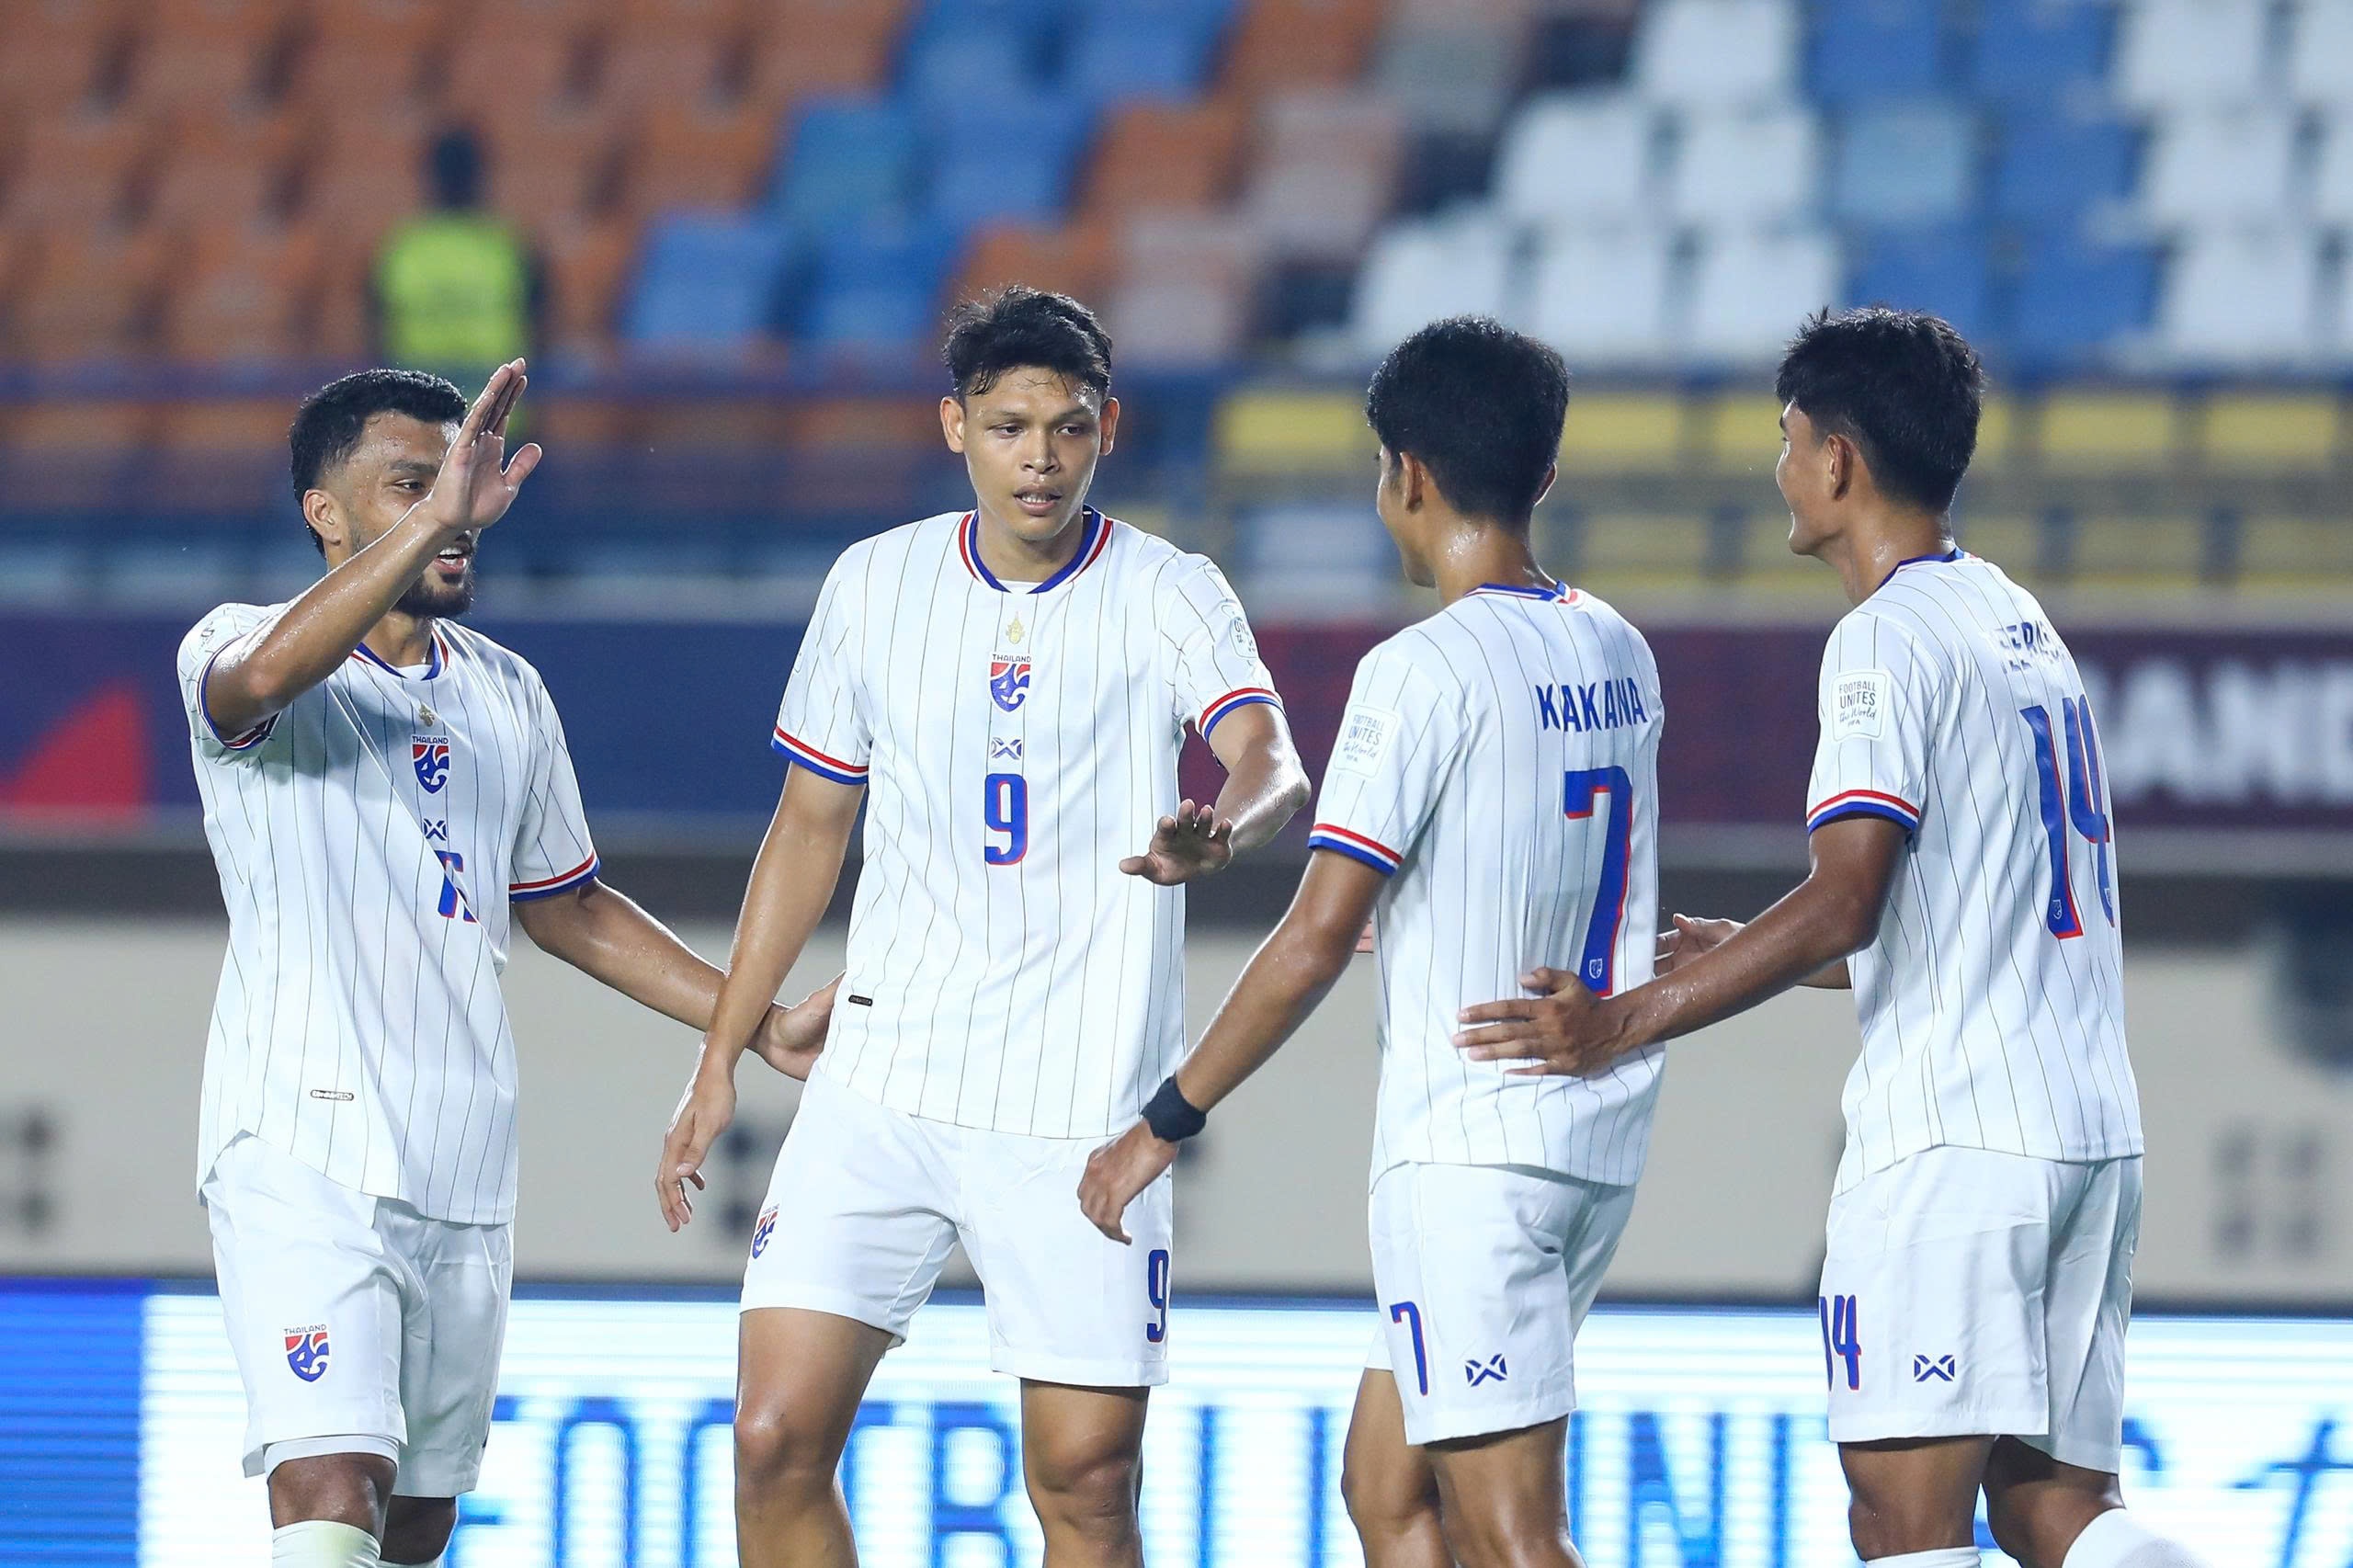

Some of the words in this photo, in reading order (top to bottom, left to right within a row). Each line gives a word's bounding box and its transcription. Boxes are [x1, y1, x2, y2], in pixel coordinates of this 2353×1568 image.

[993, 653, 1031, 663] THAILAND
[1535, 676, 1648, 733] KAKANA
[1839, 680, 1876, 694] FOOTBALL
[1839, 691, 1876, 709] UNITES
[413, 735, 449, 744] THAILAND
[1348, 725, 1382, 745] UNITES
[984, 773, 1028, 866] 9
[2019, 694, 2114, 939] 14
[1564, 765, 1633, 1000] 7
[1146, 1249, 1169, 1343] 9
[283, 1324, 327, 1335] THAILAND
[1389, 1301, 1429, 1396] 7
[1819, 1294, 1861, 1392] 14
